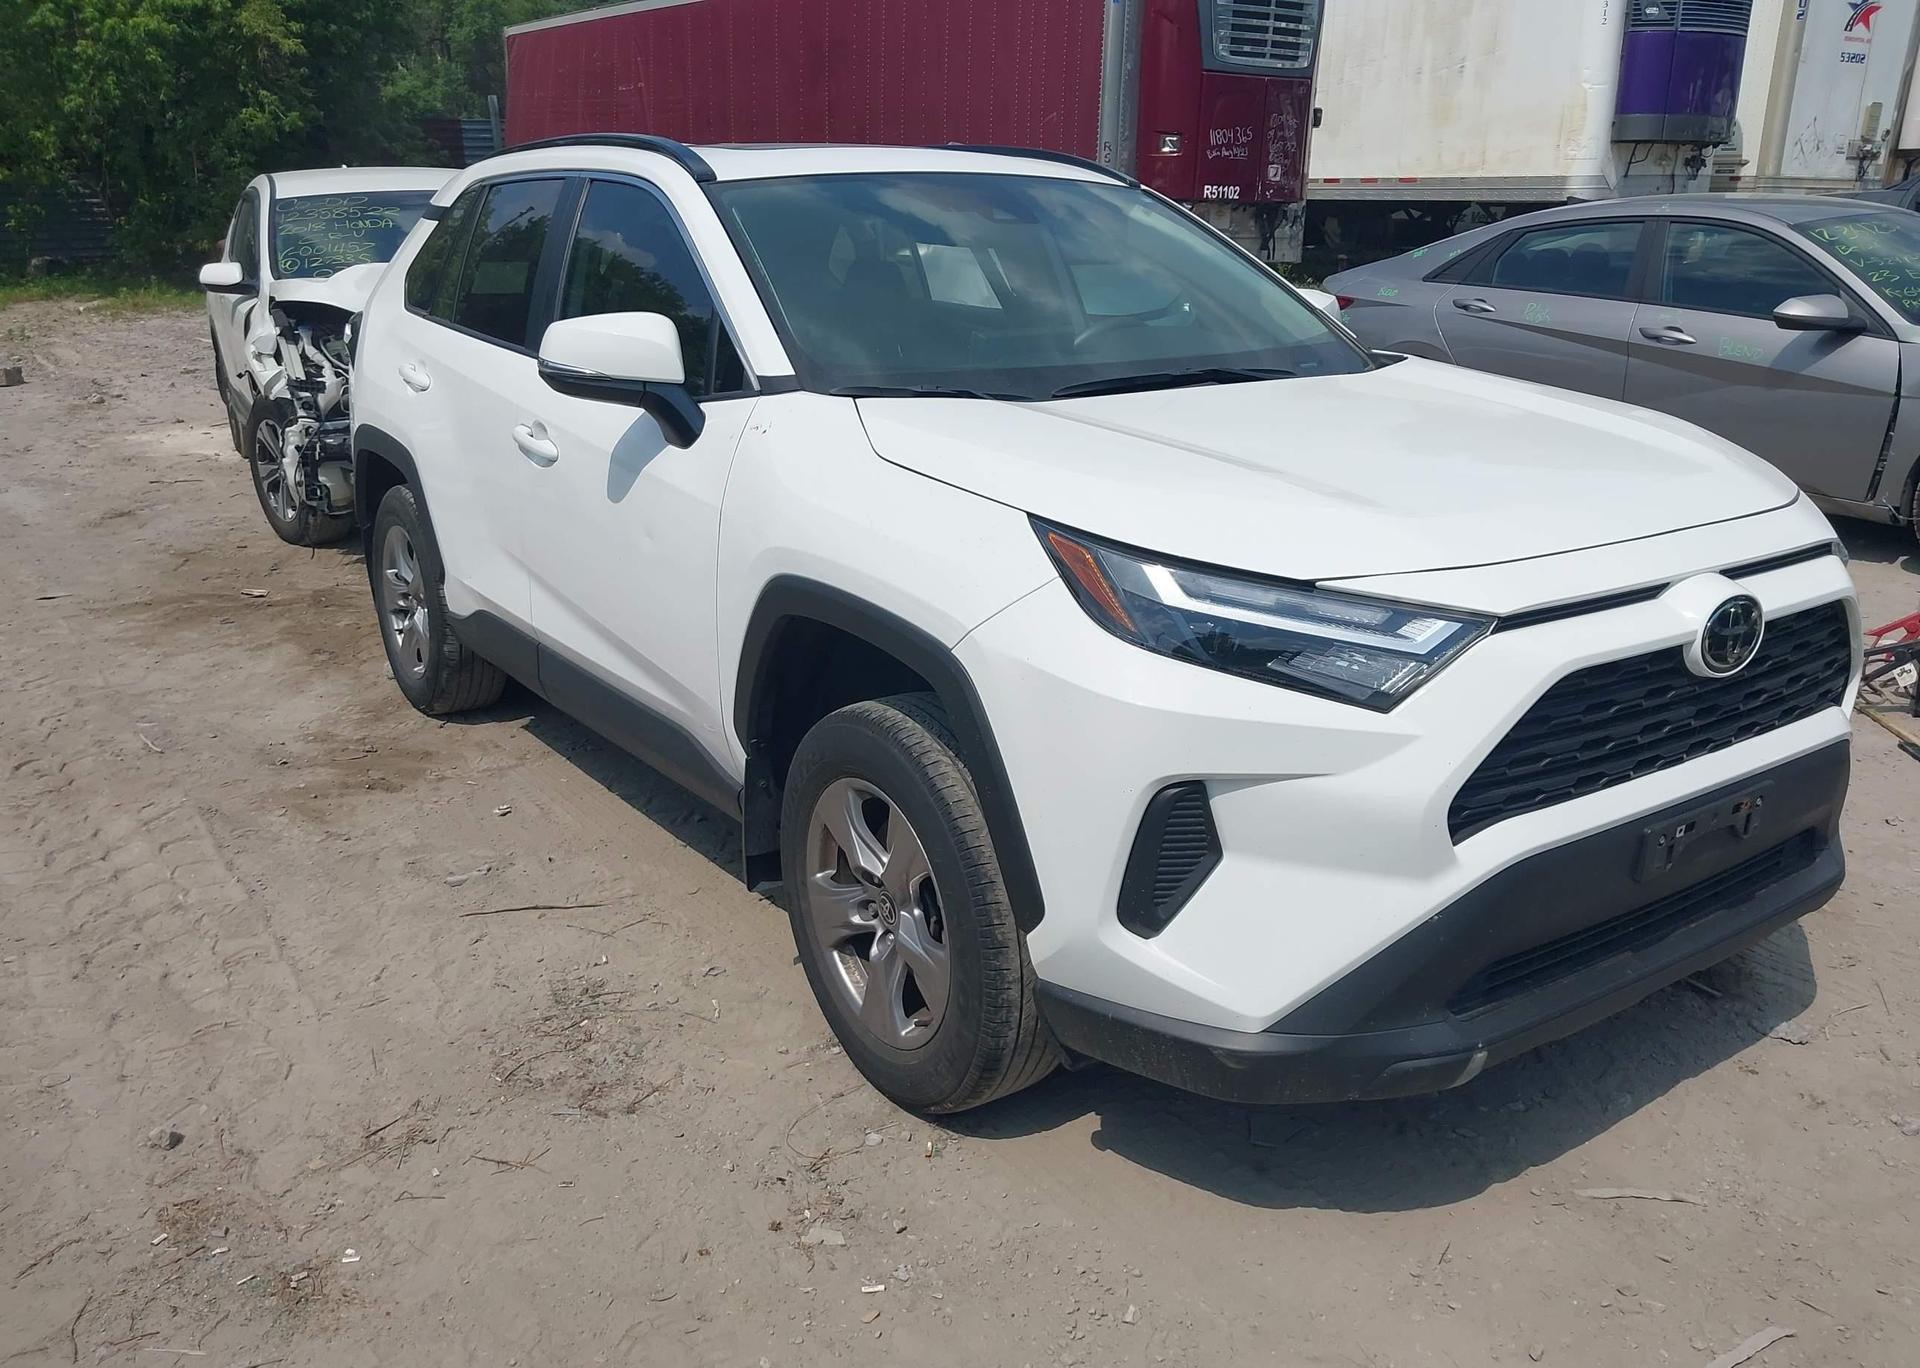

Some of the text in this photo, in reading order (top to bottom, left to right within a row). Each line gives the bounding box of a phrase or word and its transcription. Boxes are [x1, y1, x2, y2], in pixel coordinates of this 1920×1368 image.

[1840, 51, 1866, 64] 53202
[1209, 126, 1253, 147] 11804365
[1203, 185, 1241, 199] R51102
